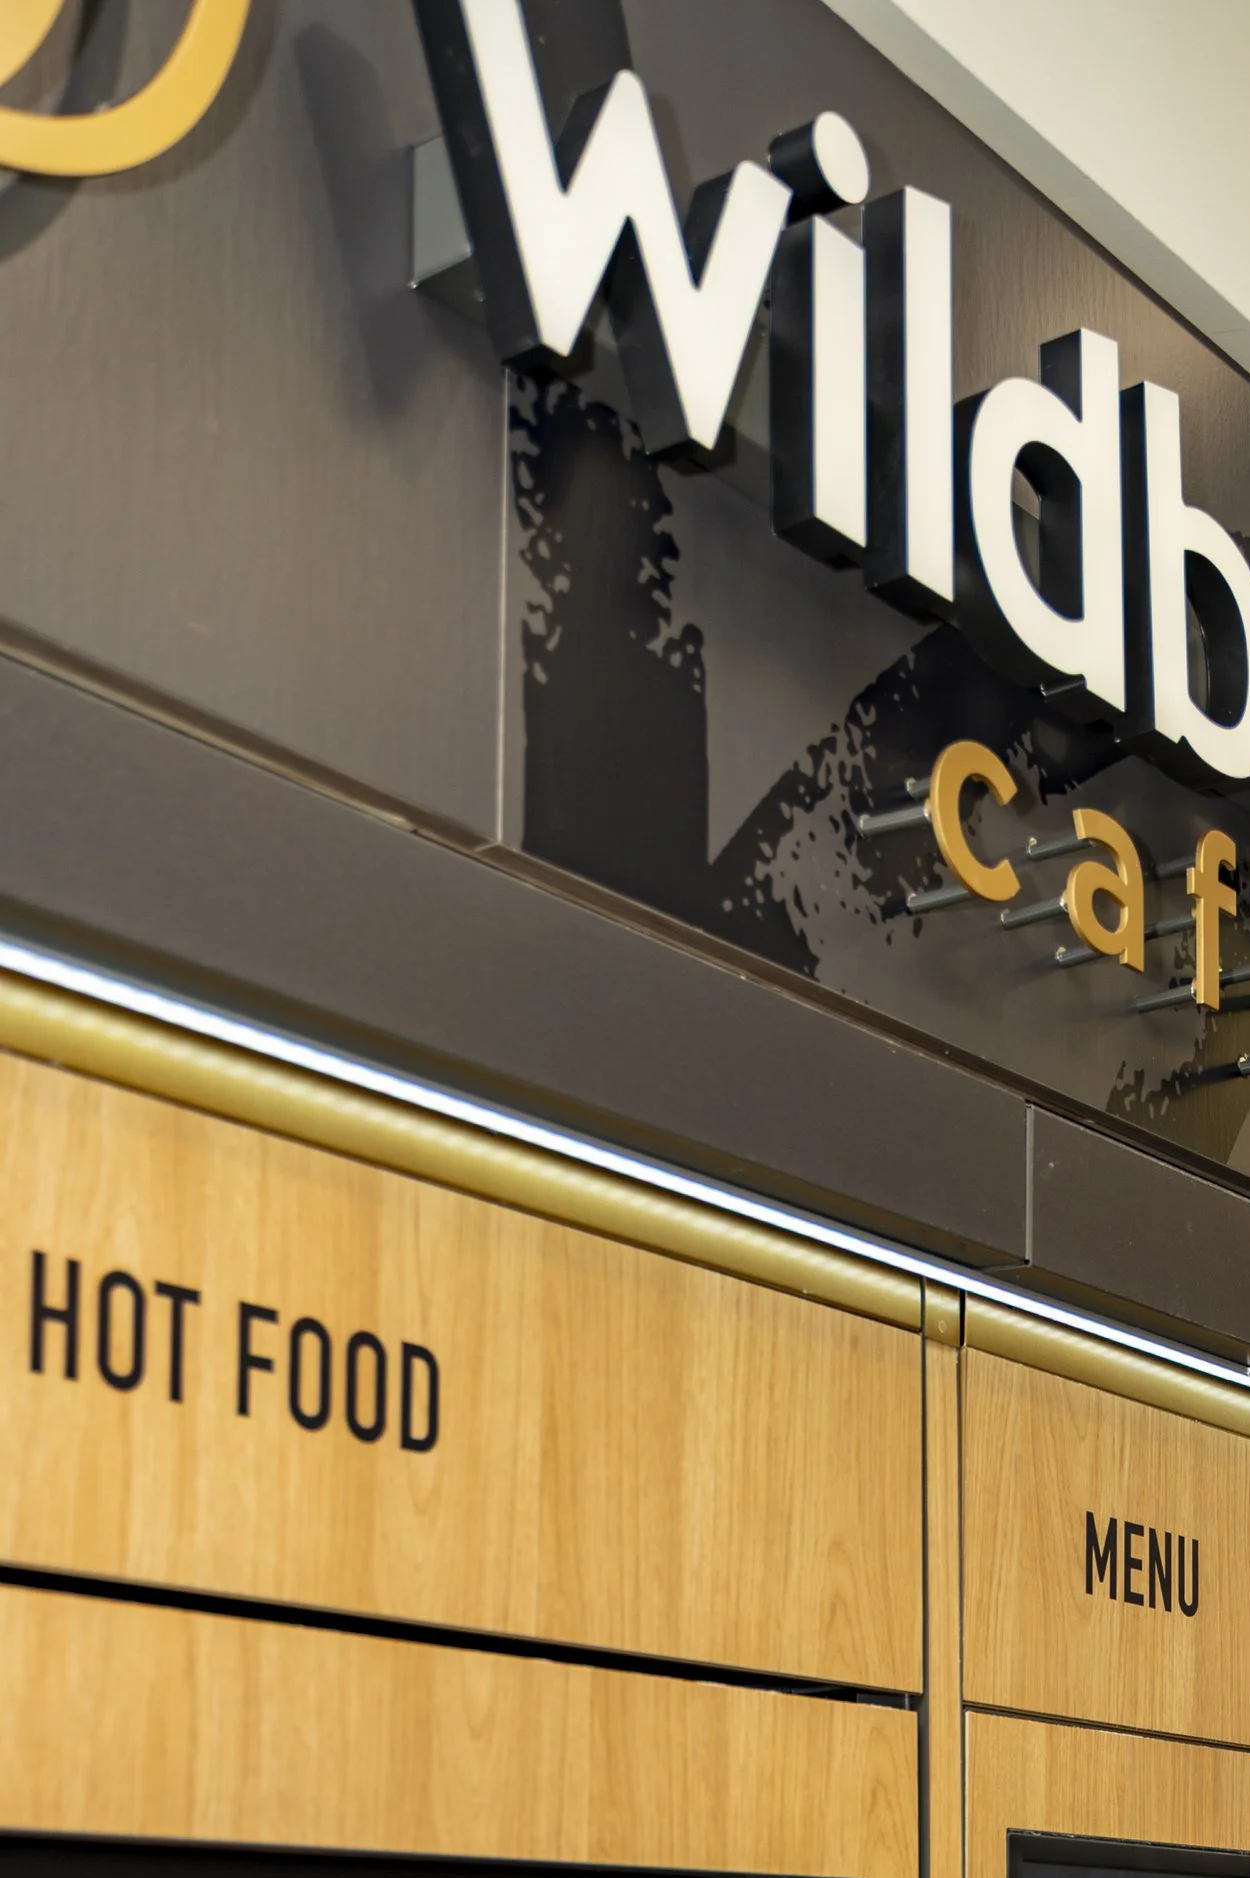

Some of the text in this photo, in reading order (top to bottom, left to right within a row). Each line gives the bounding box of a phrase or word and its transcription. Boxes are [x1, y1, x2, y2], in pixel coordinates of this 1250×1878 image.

[30, 1250, 439, 1453] HOT FOOD
[1085, 1511, 1199, 1617] MENU
